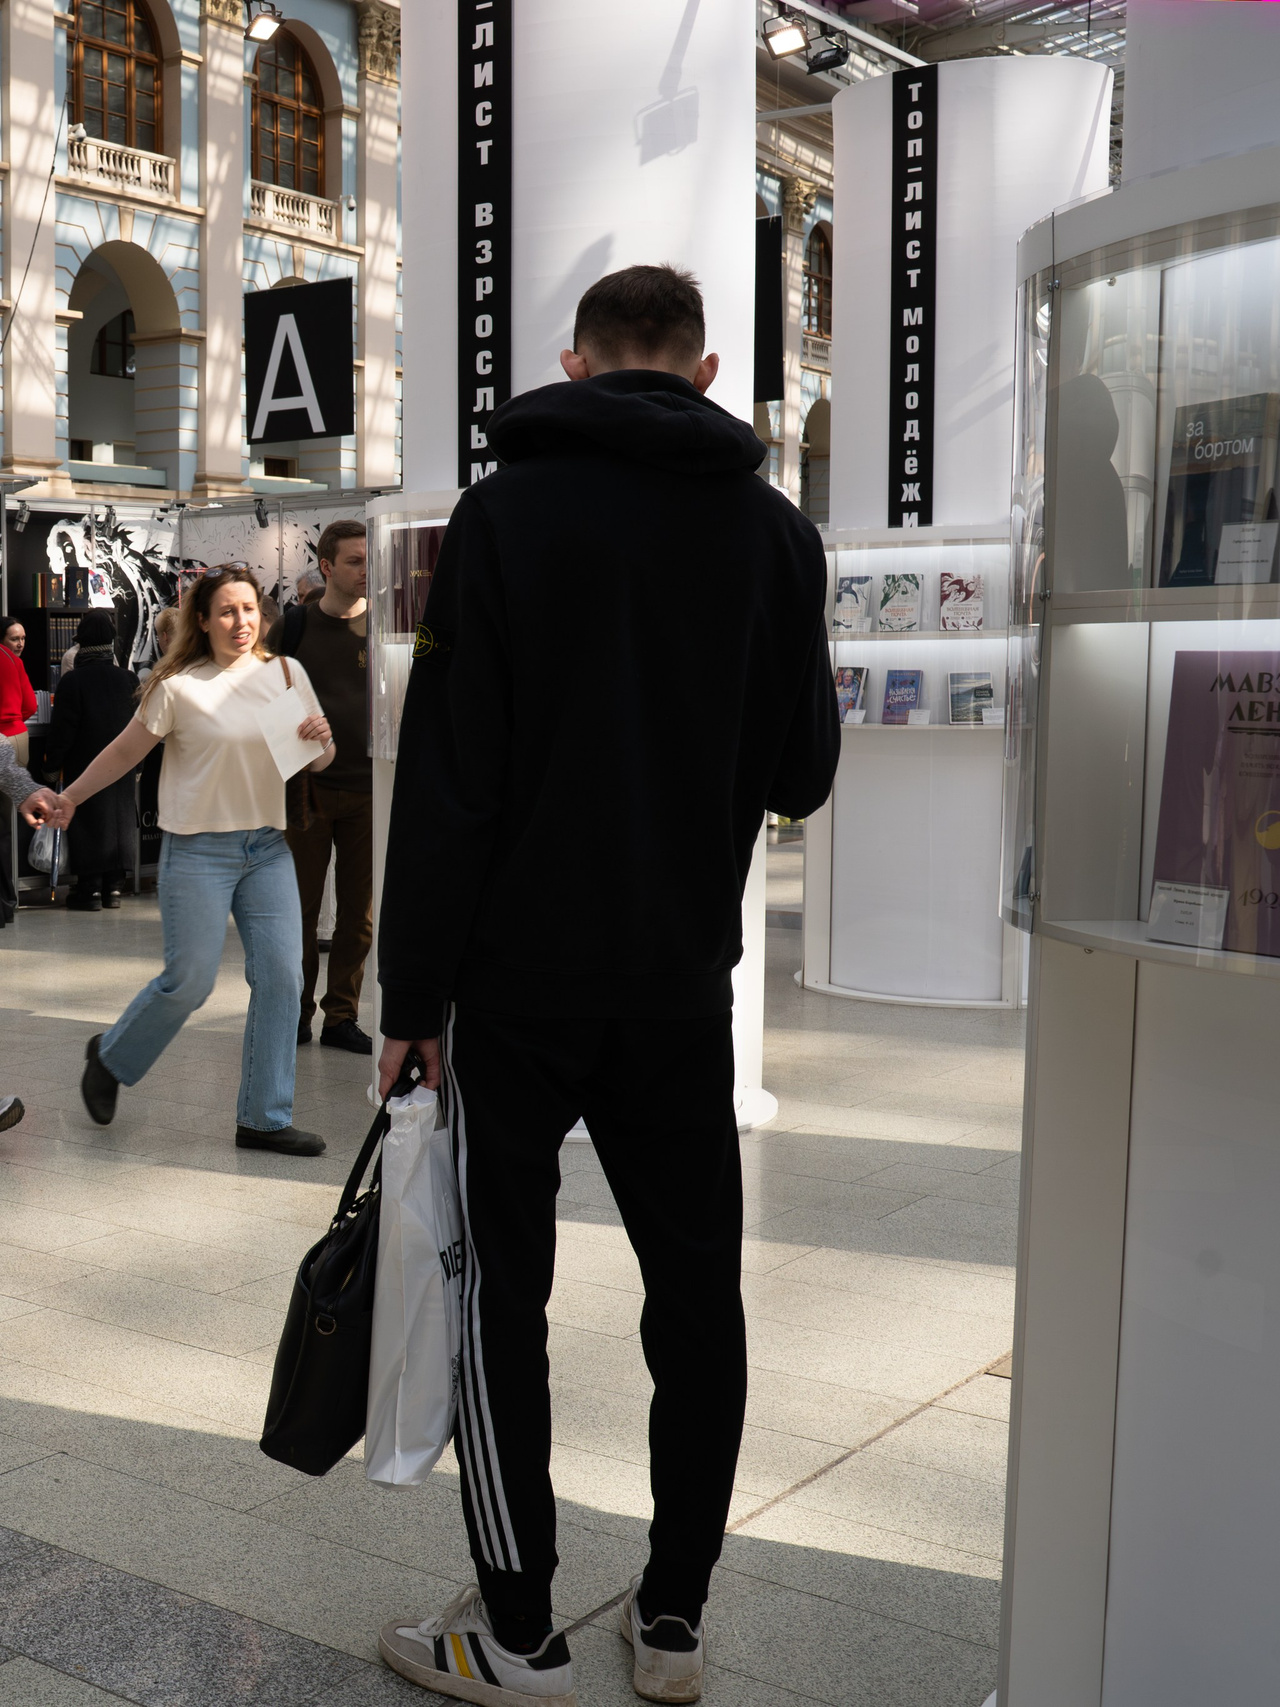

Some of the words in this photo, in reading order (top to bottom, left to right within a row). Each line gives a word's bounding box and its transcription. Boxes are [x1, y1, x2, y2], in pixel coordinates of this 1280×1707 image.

[251, 313, 327, 440] A
[1186, 421, 1205, 438] за
[1194, 437, 1255, 461] бортом
